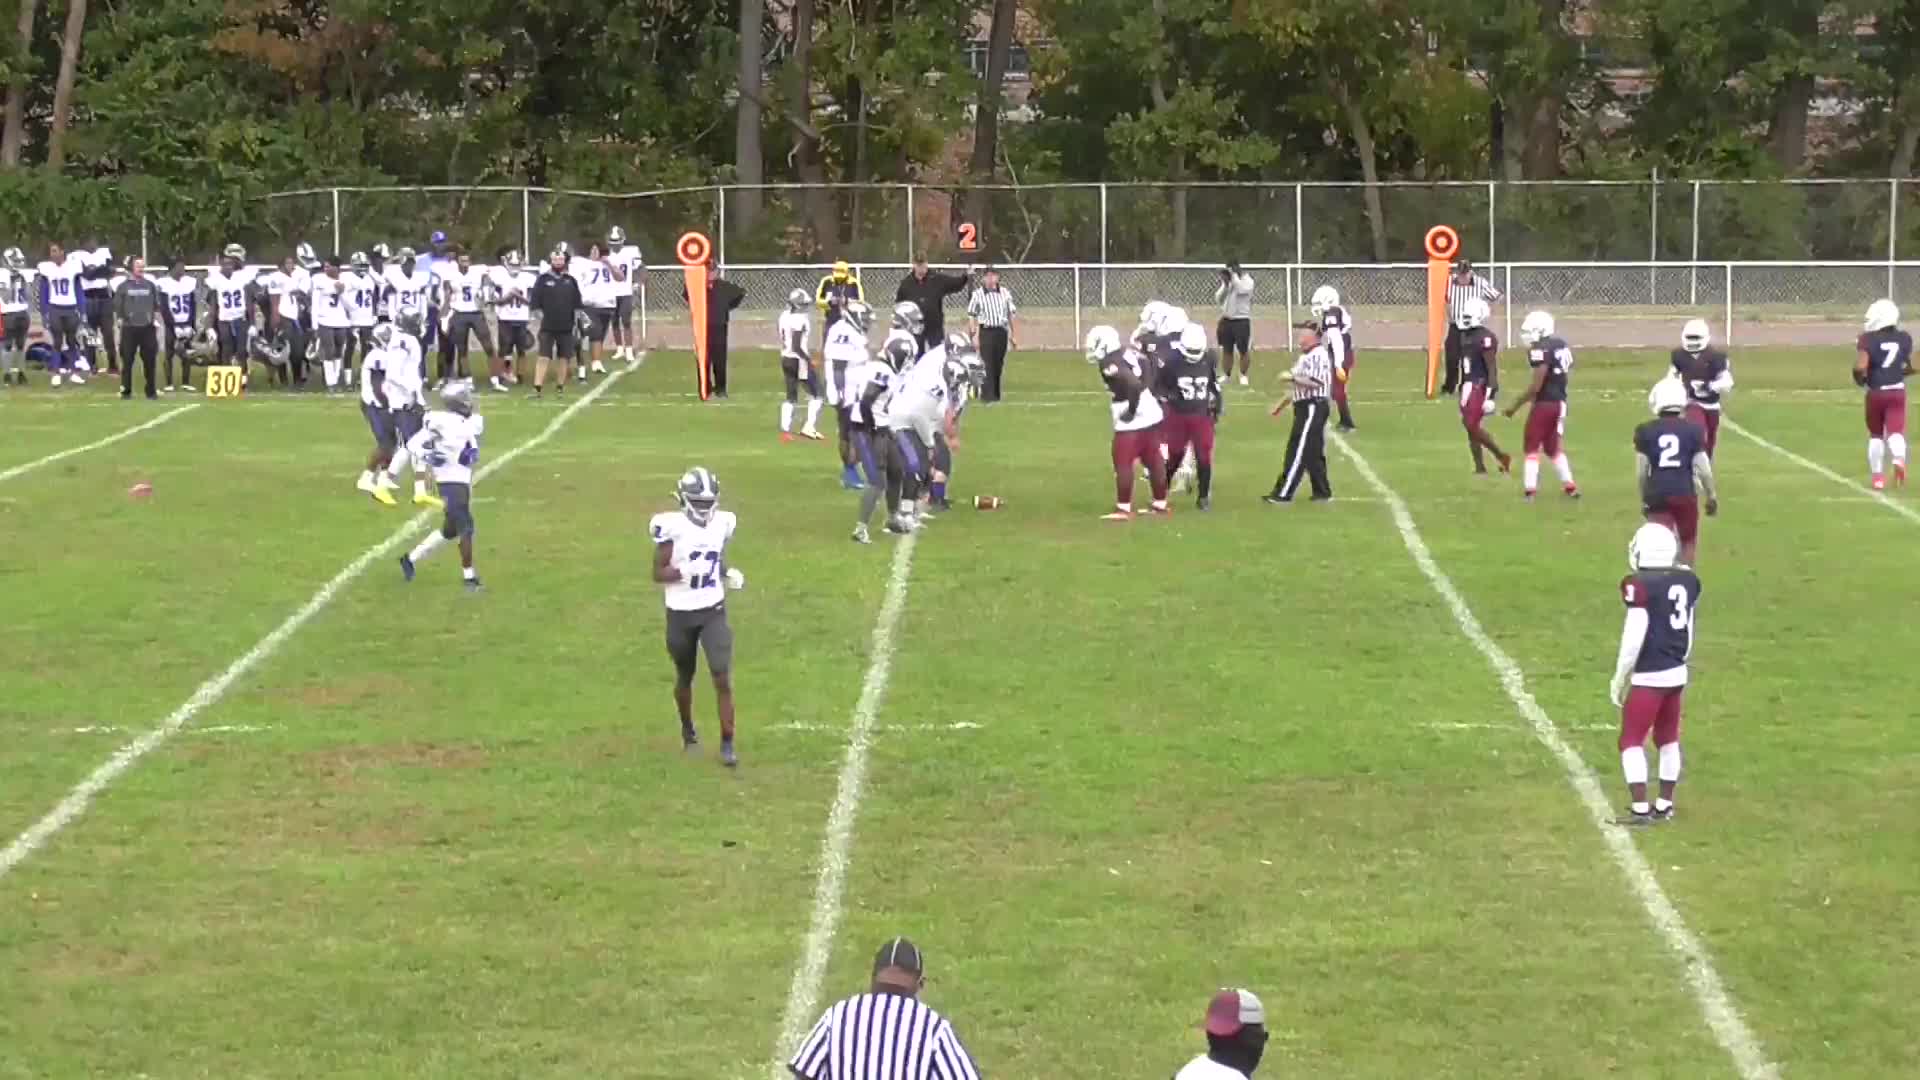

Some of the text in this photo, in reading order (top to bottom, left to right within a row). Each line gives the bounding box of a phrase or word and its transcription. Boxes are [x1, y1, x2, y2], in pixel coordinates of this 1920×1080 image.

[958, 222, 977, 249] 2
[51, 277, 70, 297] 10
[223, 290, 242, 309] 32
[1880, 342, 1900, 369] 7
[210, 371, 236, 395] 30
[1658, 434, 1681, 467] 2
[1668, 584, 1688, 630] 3
